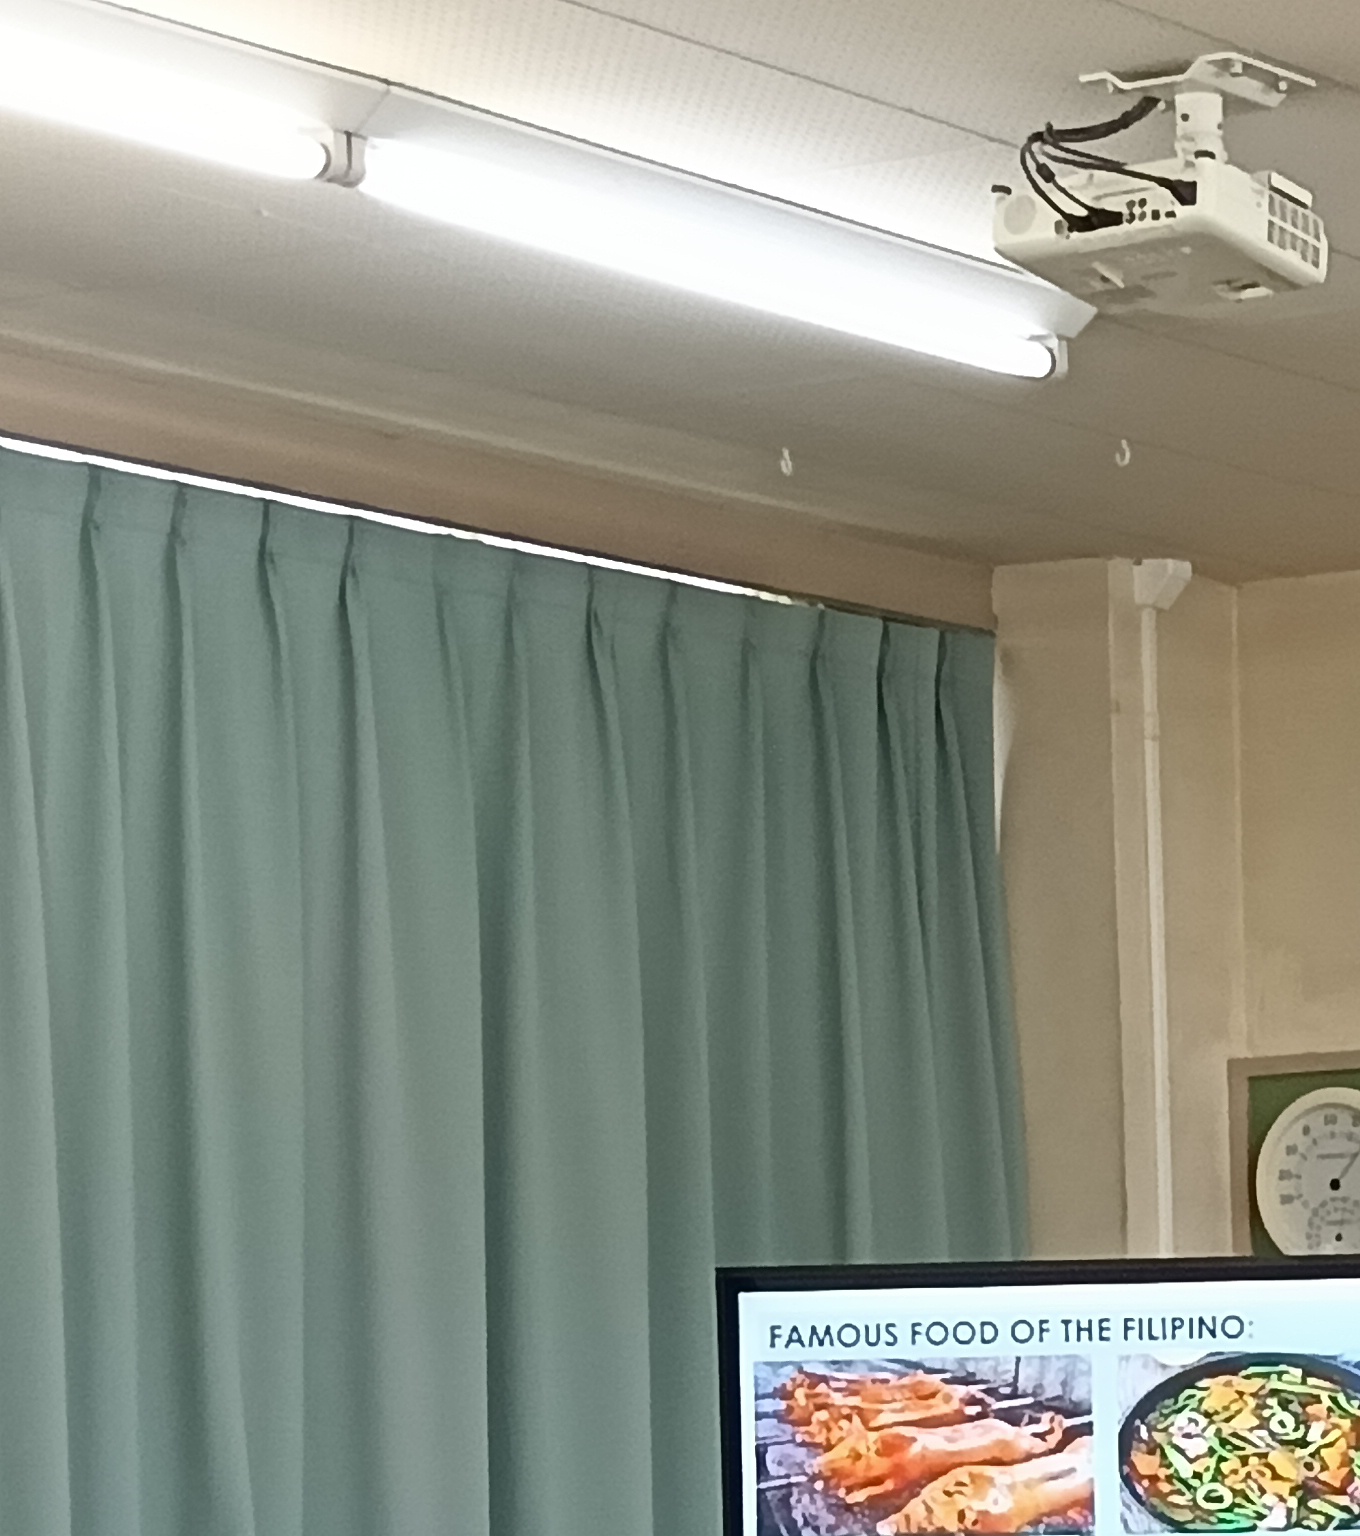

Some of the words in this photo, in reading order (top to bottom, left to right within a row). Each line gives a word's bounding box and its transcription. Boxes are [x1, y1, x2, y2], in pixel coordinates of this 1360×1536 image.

[769, 1323, 898, 1349] FAMOUS
[911, 1321, 999, 1346] FOOD
[1010, 1319, 1051, 1344] OF
[1060, 1318, 1111, 1342] THE
[1123, 1315, 1254, 1342] FILIPINO:
